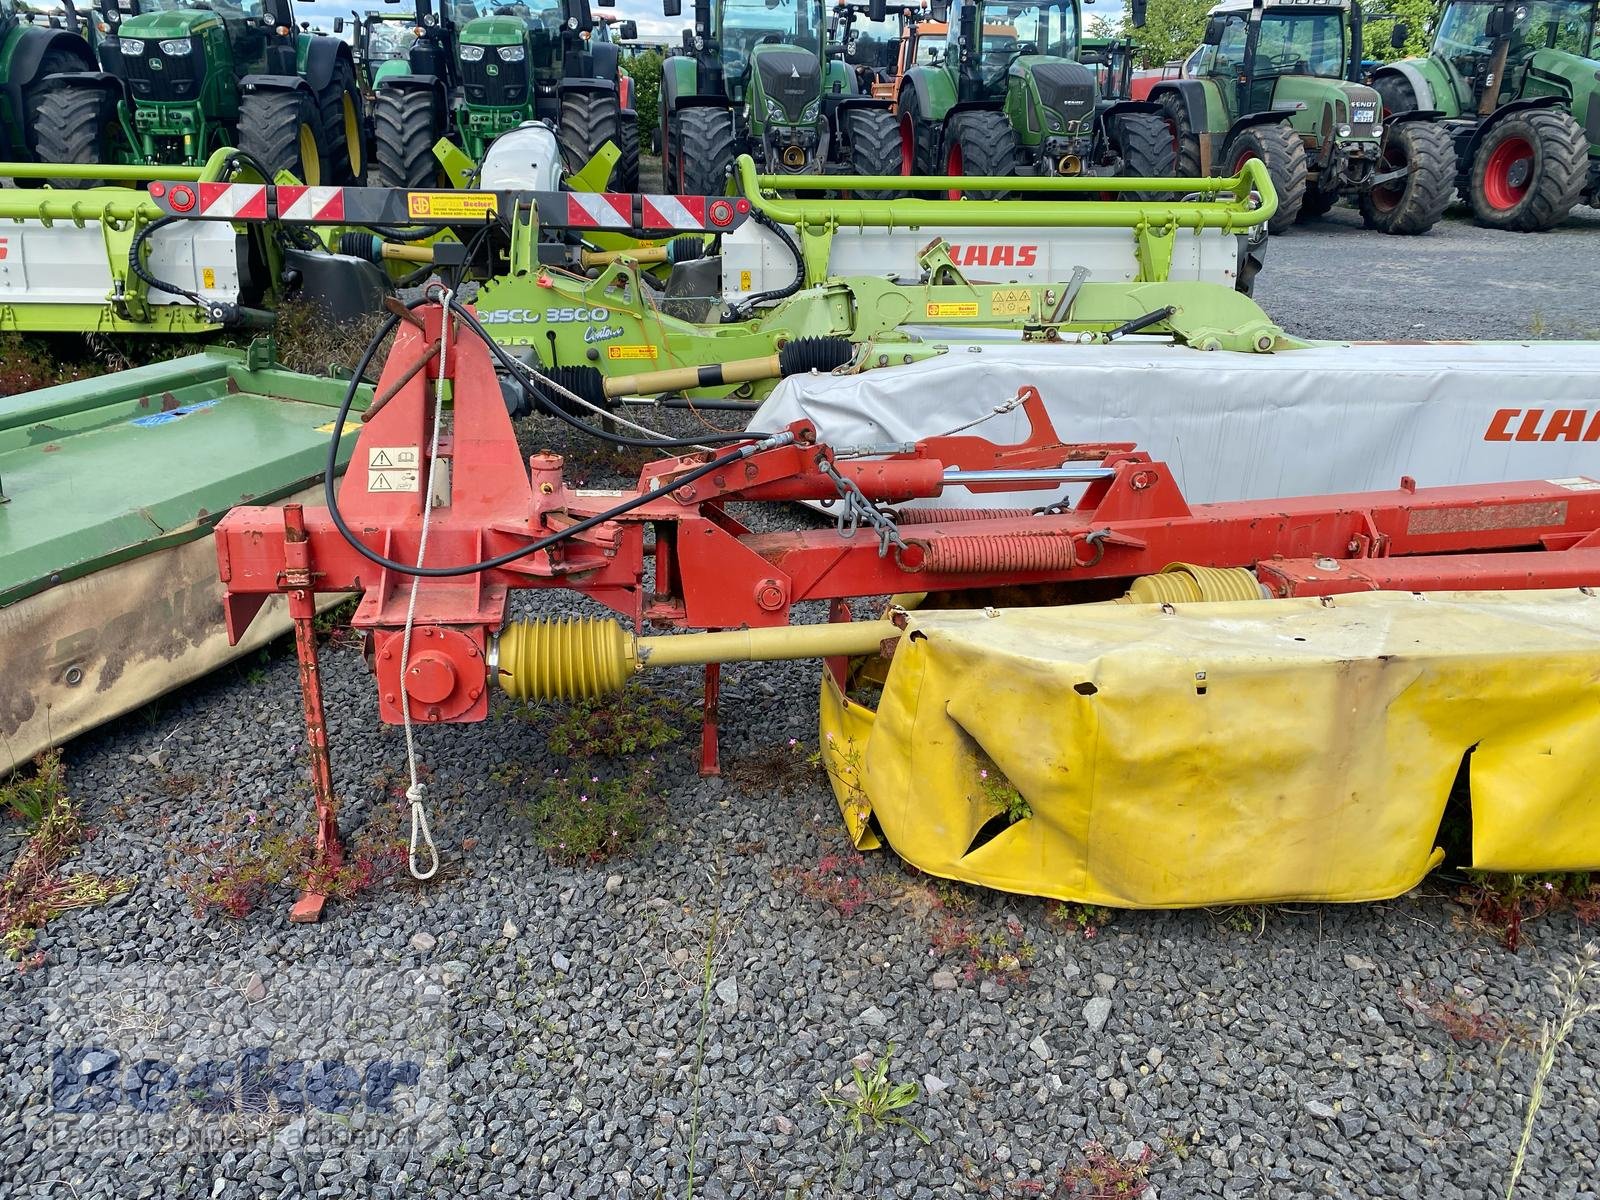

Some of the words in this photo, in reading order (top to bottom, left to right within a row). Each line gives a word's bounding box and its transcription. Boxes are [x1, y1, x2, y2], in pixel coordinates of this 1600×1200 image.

[948, 245, 1038, 266] LAAS
[477, 309, 541, 324] DISCO
[546, 307, 609, 323] 3500
